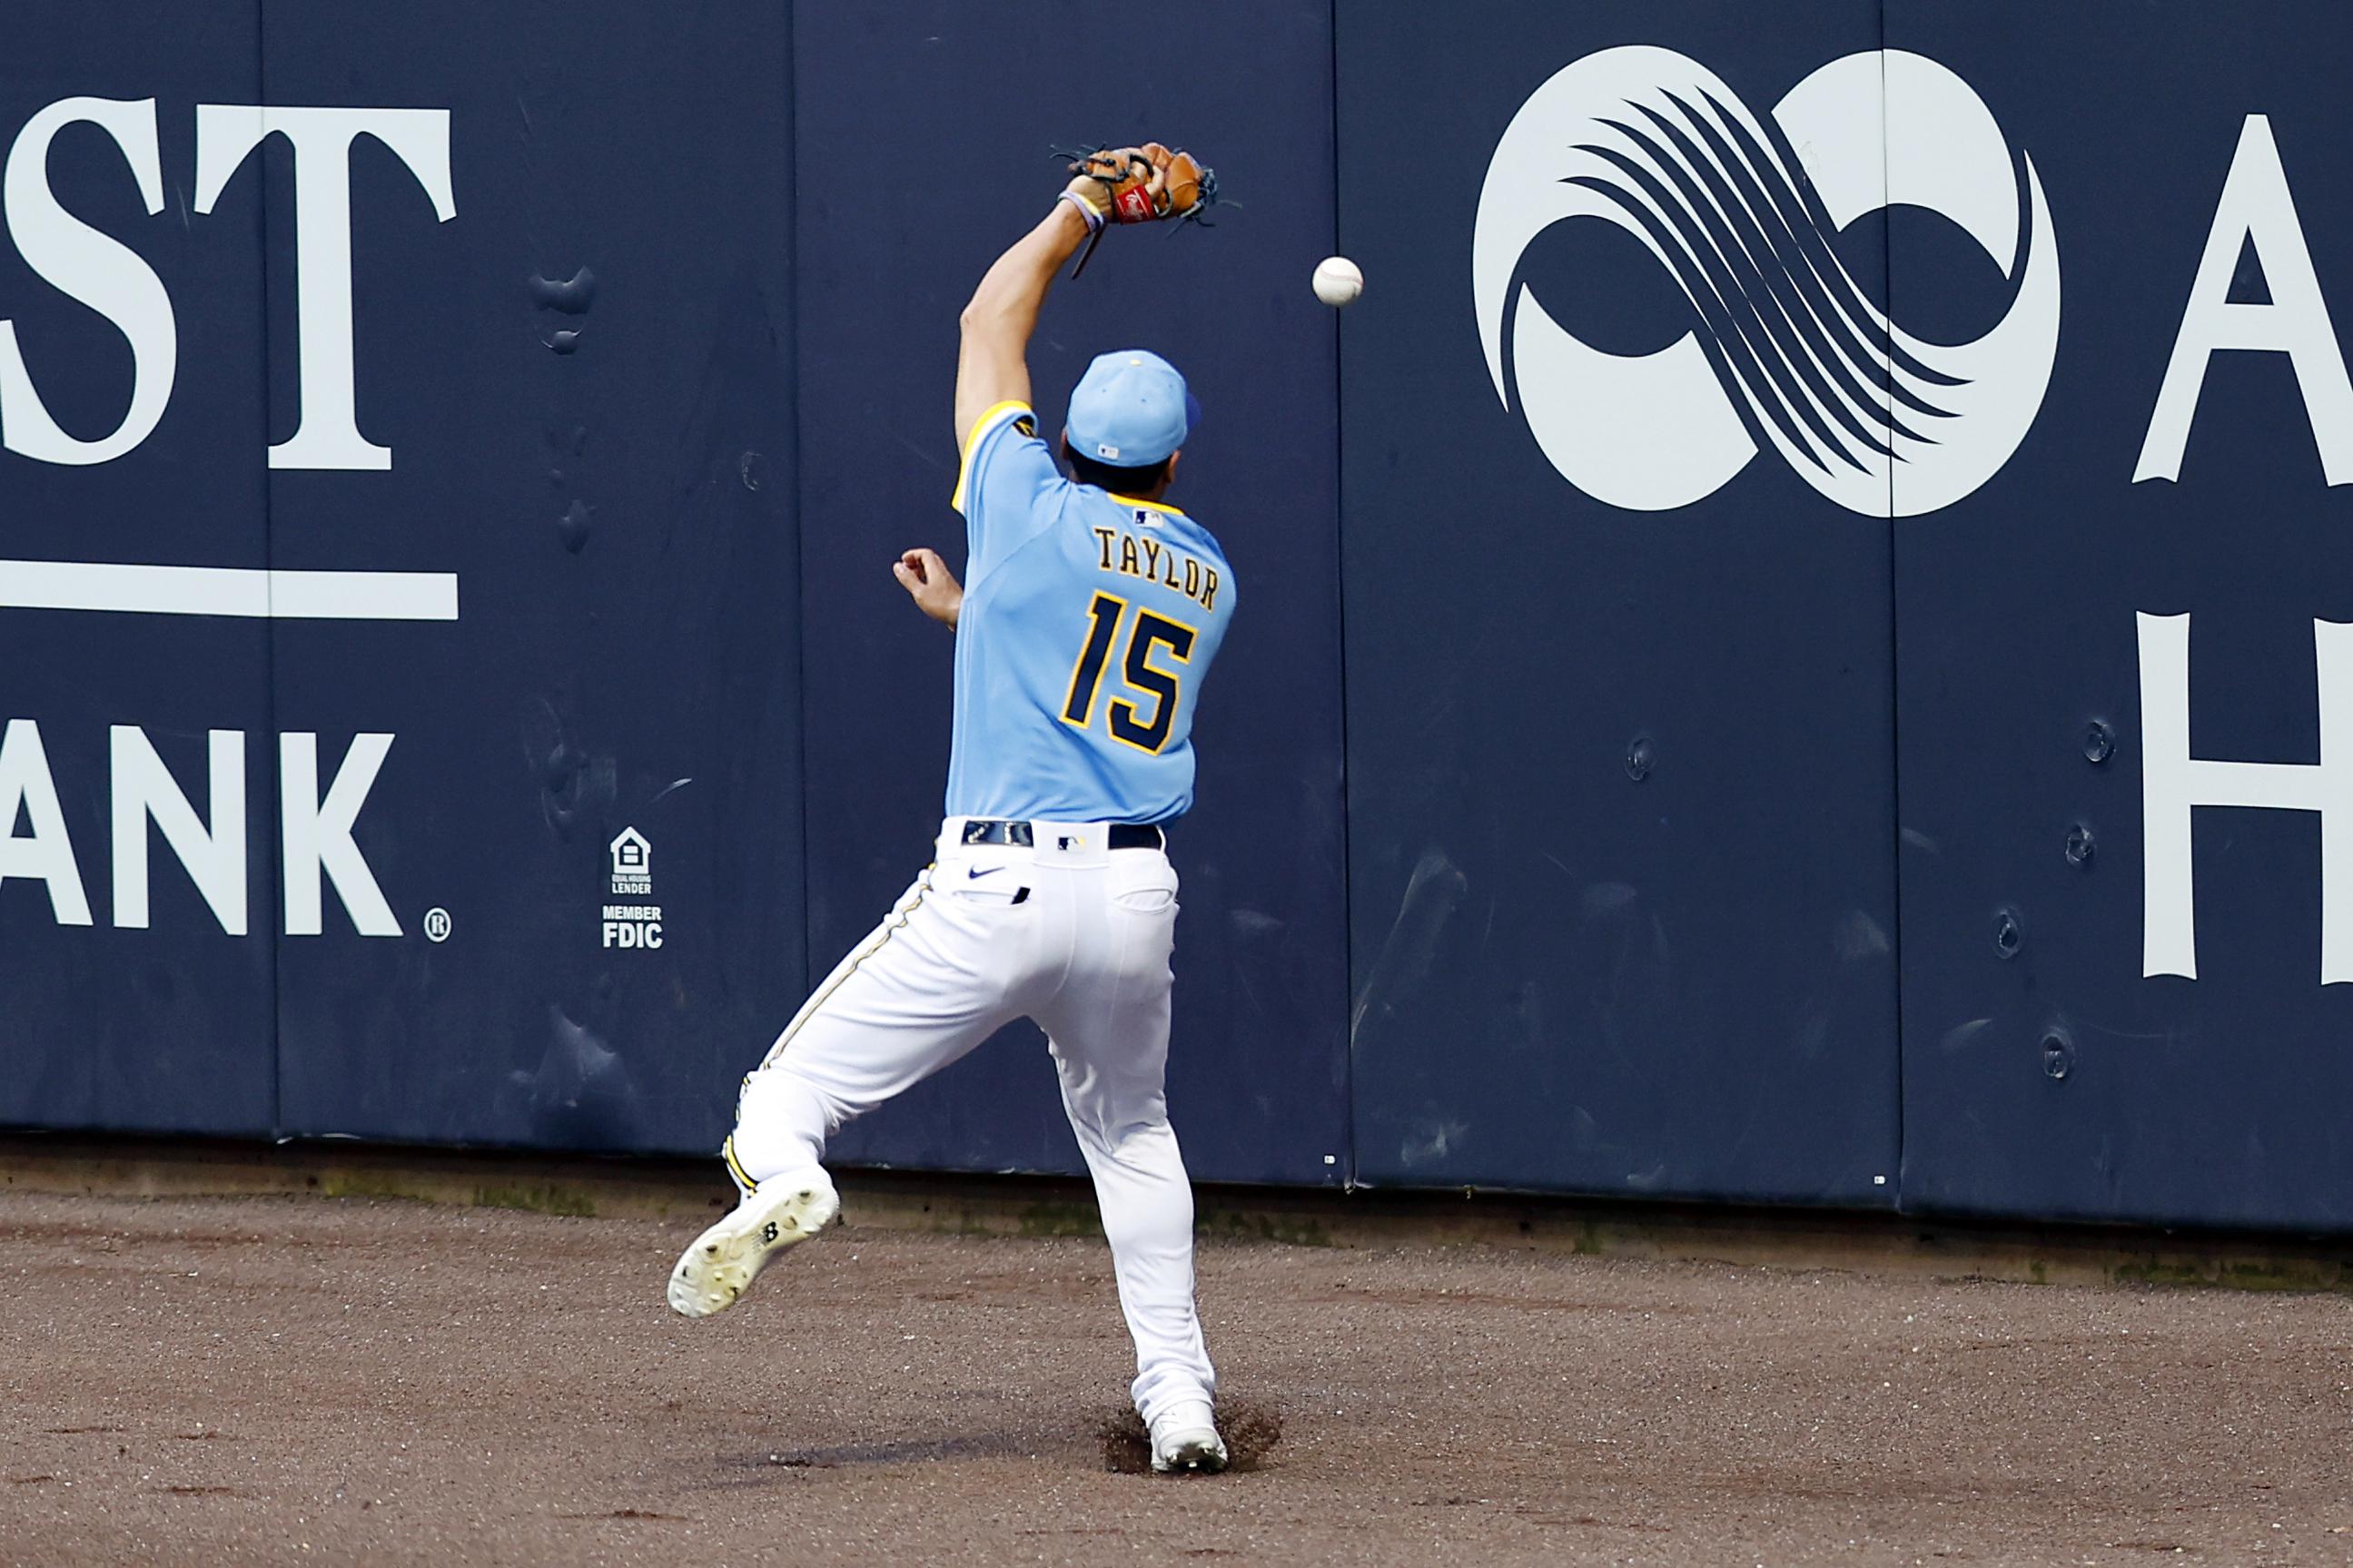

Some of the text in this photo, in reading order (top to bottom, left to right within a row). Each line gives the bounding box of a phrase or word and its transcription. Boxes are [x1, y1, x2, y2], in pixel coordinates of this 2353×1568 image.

[0, 96, 457, 470] ST
[2131, 113, 2353, 488] A
[1093, 526, 1219, 613] TAYLOR
[1058, 589, 1200, 757] 15
[0, 718, 404, 937] ANK
[2136, 610, 2353, 986] H
[602, 905, 662, 921] MEMBER
[603, 922, 663, 949] FDIC
[612, 883, 652, 894] LENDER
